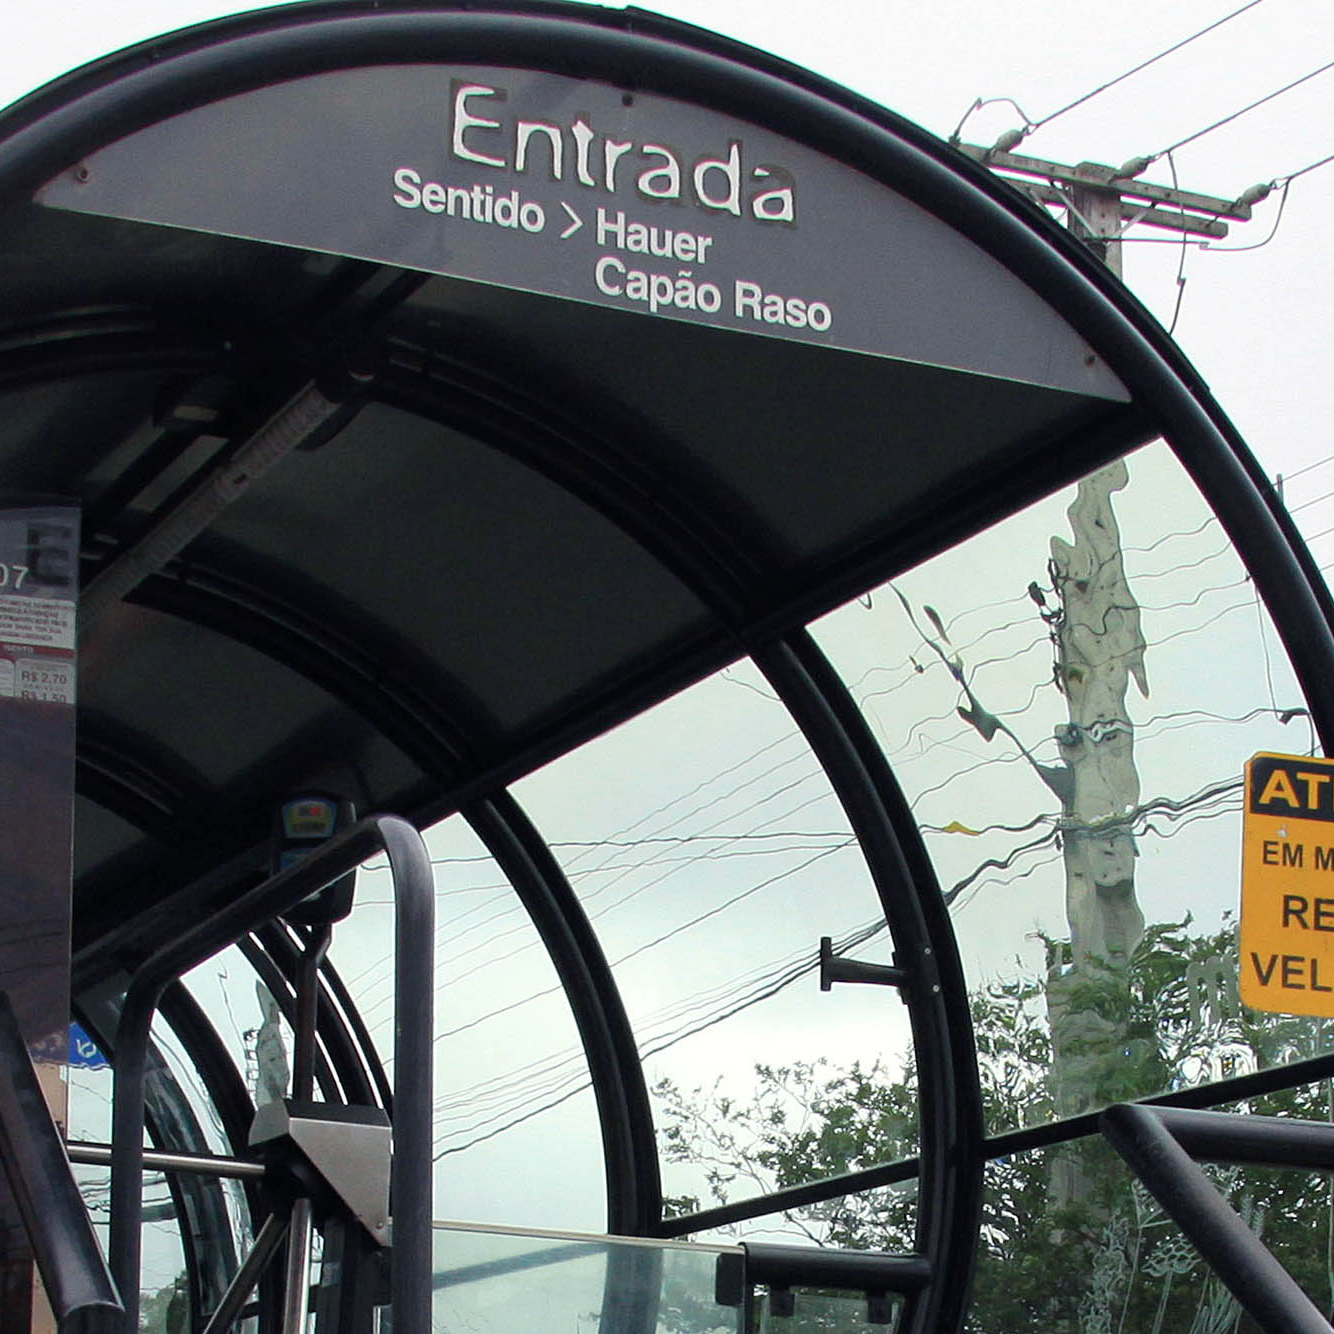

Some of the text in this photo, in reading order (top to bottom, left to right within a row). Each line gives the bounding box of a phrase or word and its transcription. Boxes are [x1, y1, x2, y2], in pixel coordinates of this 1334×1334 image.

[452, 84, 796, 222] Entrada
[392, 168, 546, 233] Sentido
[596, 207, 713, 264] Hauer
[594, 256, 833, 332] Capão Raso
[1262, 840, 1304, 869] EM
